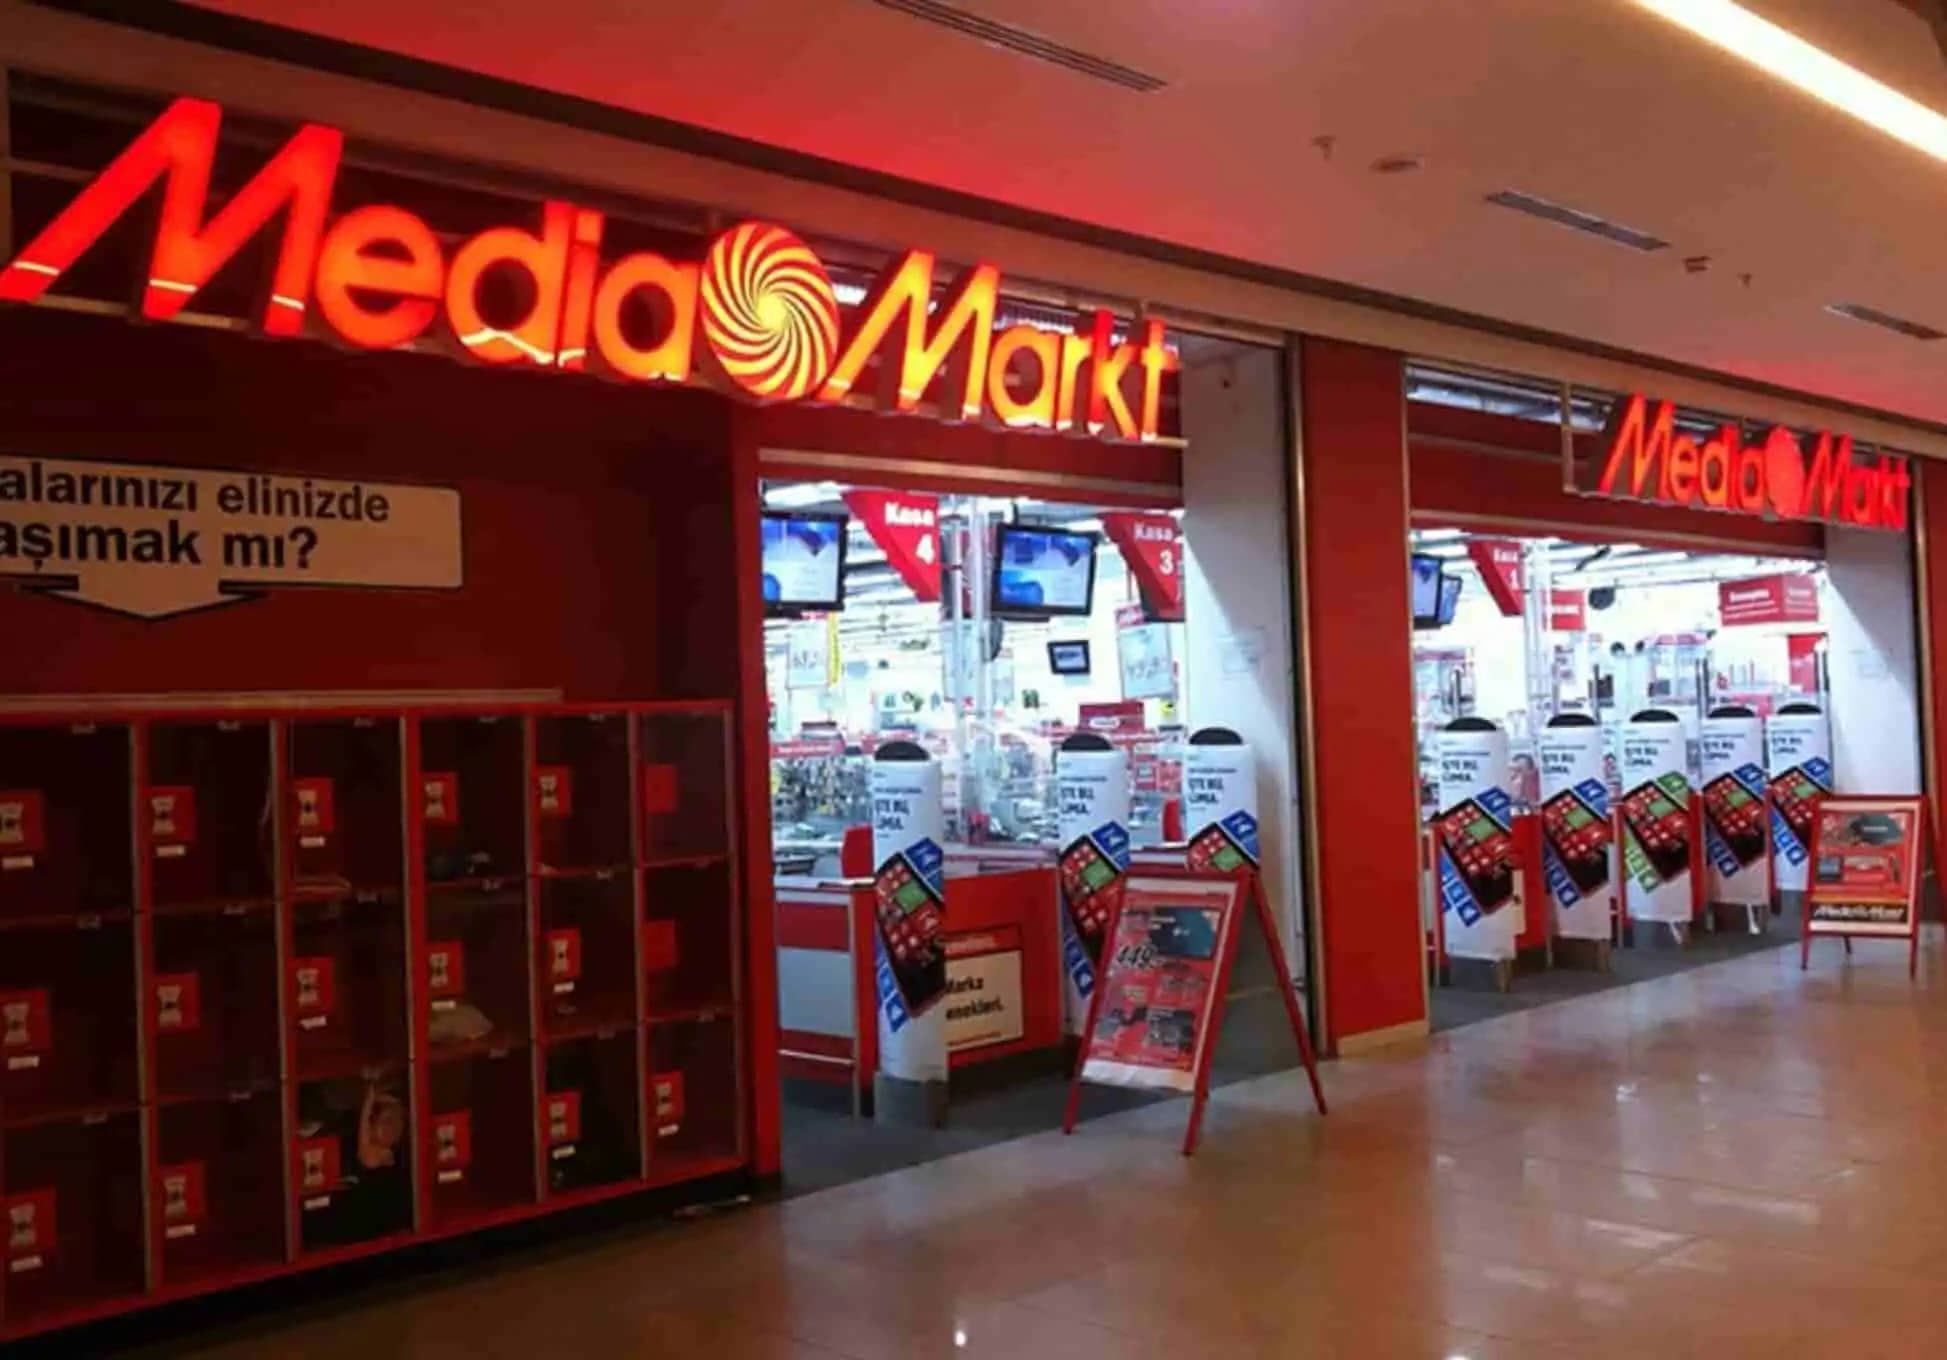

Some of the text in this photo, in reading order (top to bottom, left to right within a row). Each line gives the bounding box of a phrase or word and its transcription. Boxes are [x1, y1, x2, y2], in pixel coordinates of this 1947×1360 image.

[0, 97, 1181, 441] Media Markt
[1600, 392, 1911, 530] Media Markt
[217, 476, 390, 522] elinizde
[884, 502, 936, 527] Kasa
[223, 527, 318, 569] mı?
[914, 533, 936, 565] 4
[1133, 522, 1174, 541] Kasa
[1159, 548, 1174, 575] 3
